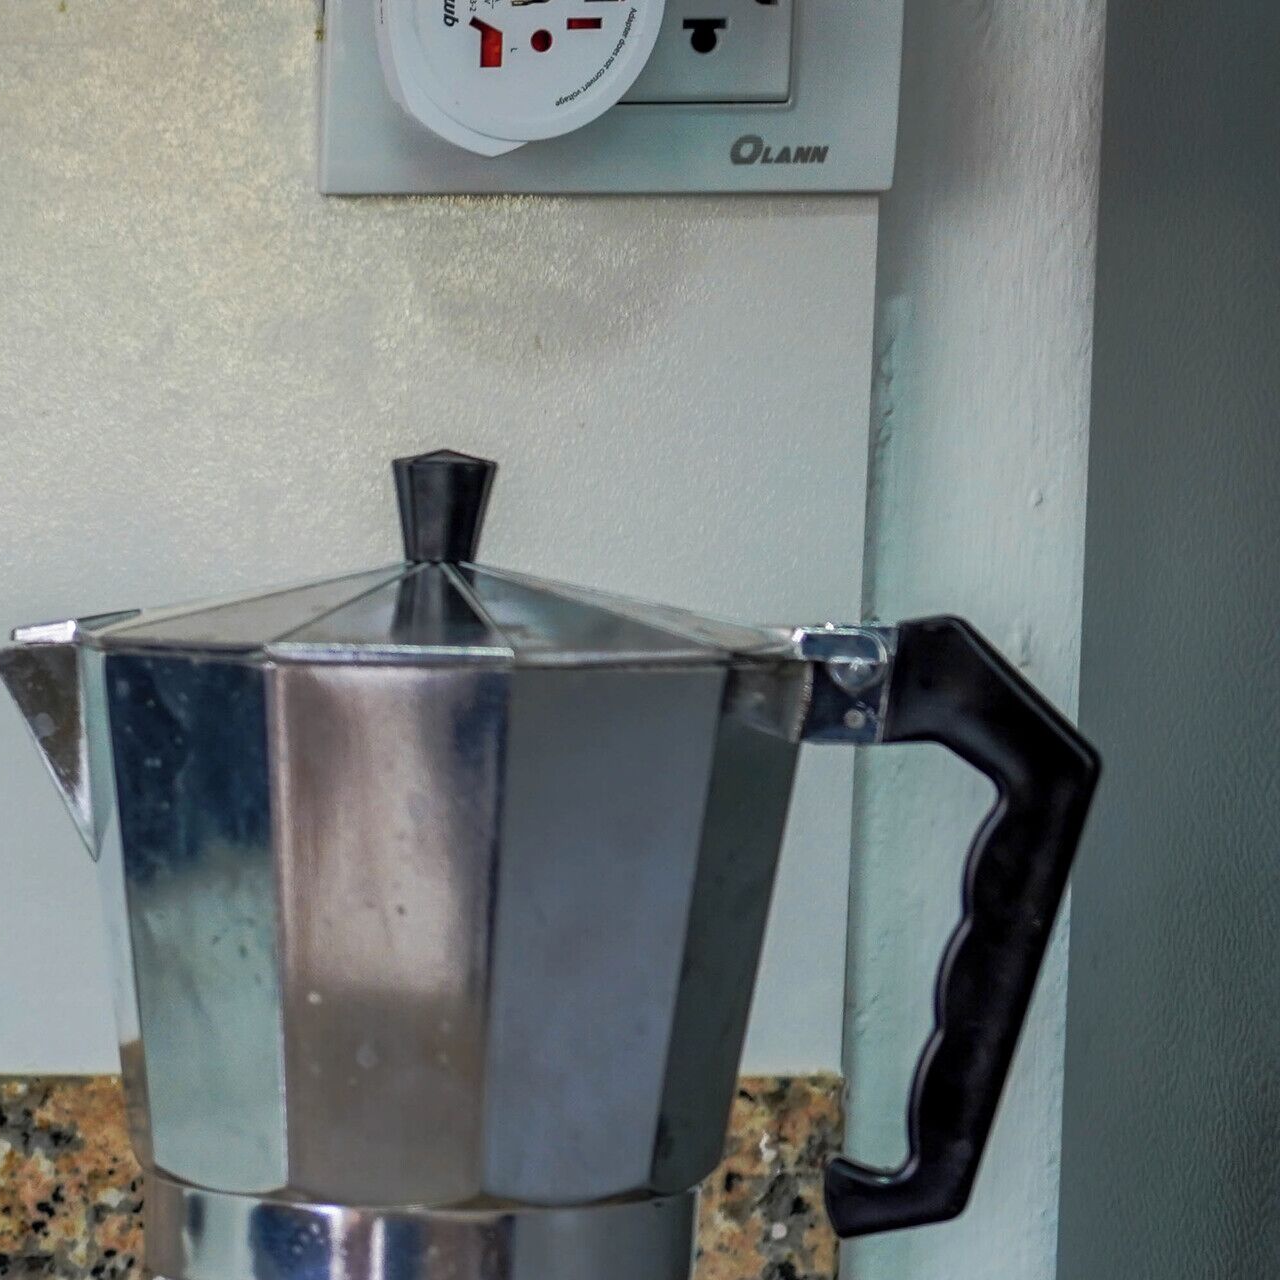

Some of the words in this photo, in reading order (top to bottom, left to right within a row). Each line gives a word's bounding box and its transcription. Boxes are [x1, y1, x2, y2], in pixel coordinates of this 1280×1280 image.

[622, 7, 638, 38] Adapter
[612, 38, 625, 56] does
[603, 56, 615, 70] not
[581, 68, 605, 92] convert
[555, 89, 582, 107] voltage
[730, 134, 830, 166] OLANN
